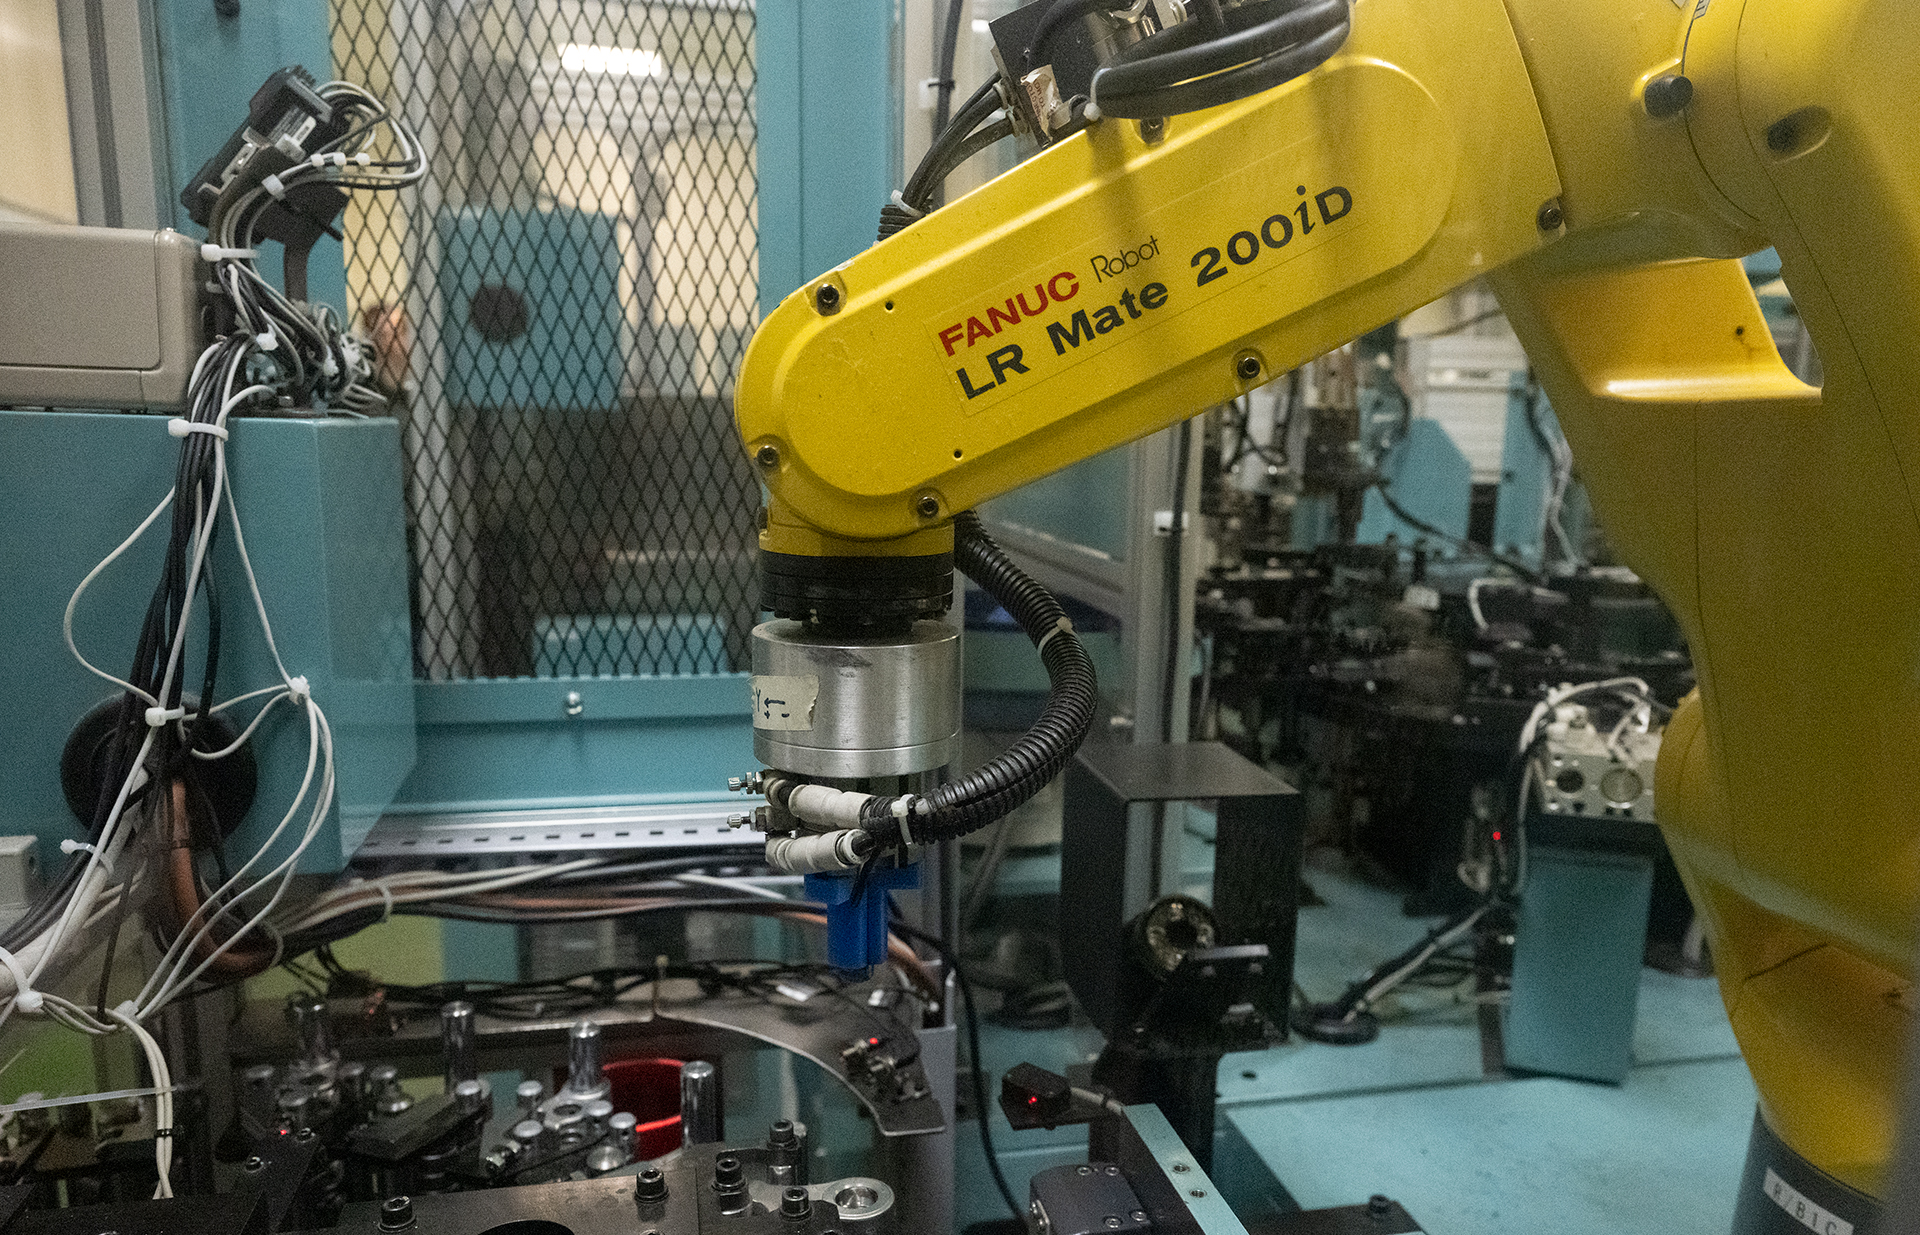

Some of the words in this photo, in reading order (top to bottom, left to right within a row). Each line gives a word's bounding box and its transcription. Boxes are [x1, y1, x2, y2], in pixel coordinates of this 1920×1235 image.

[938, 271, 1080, 357] FANUC
[1090, 235, 1160, 283] Robot
[955, 343, 1031, 400] LR
[1045, 281, 1169, 357] Mate
[1190, 185, 1354, 287] 200iD
